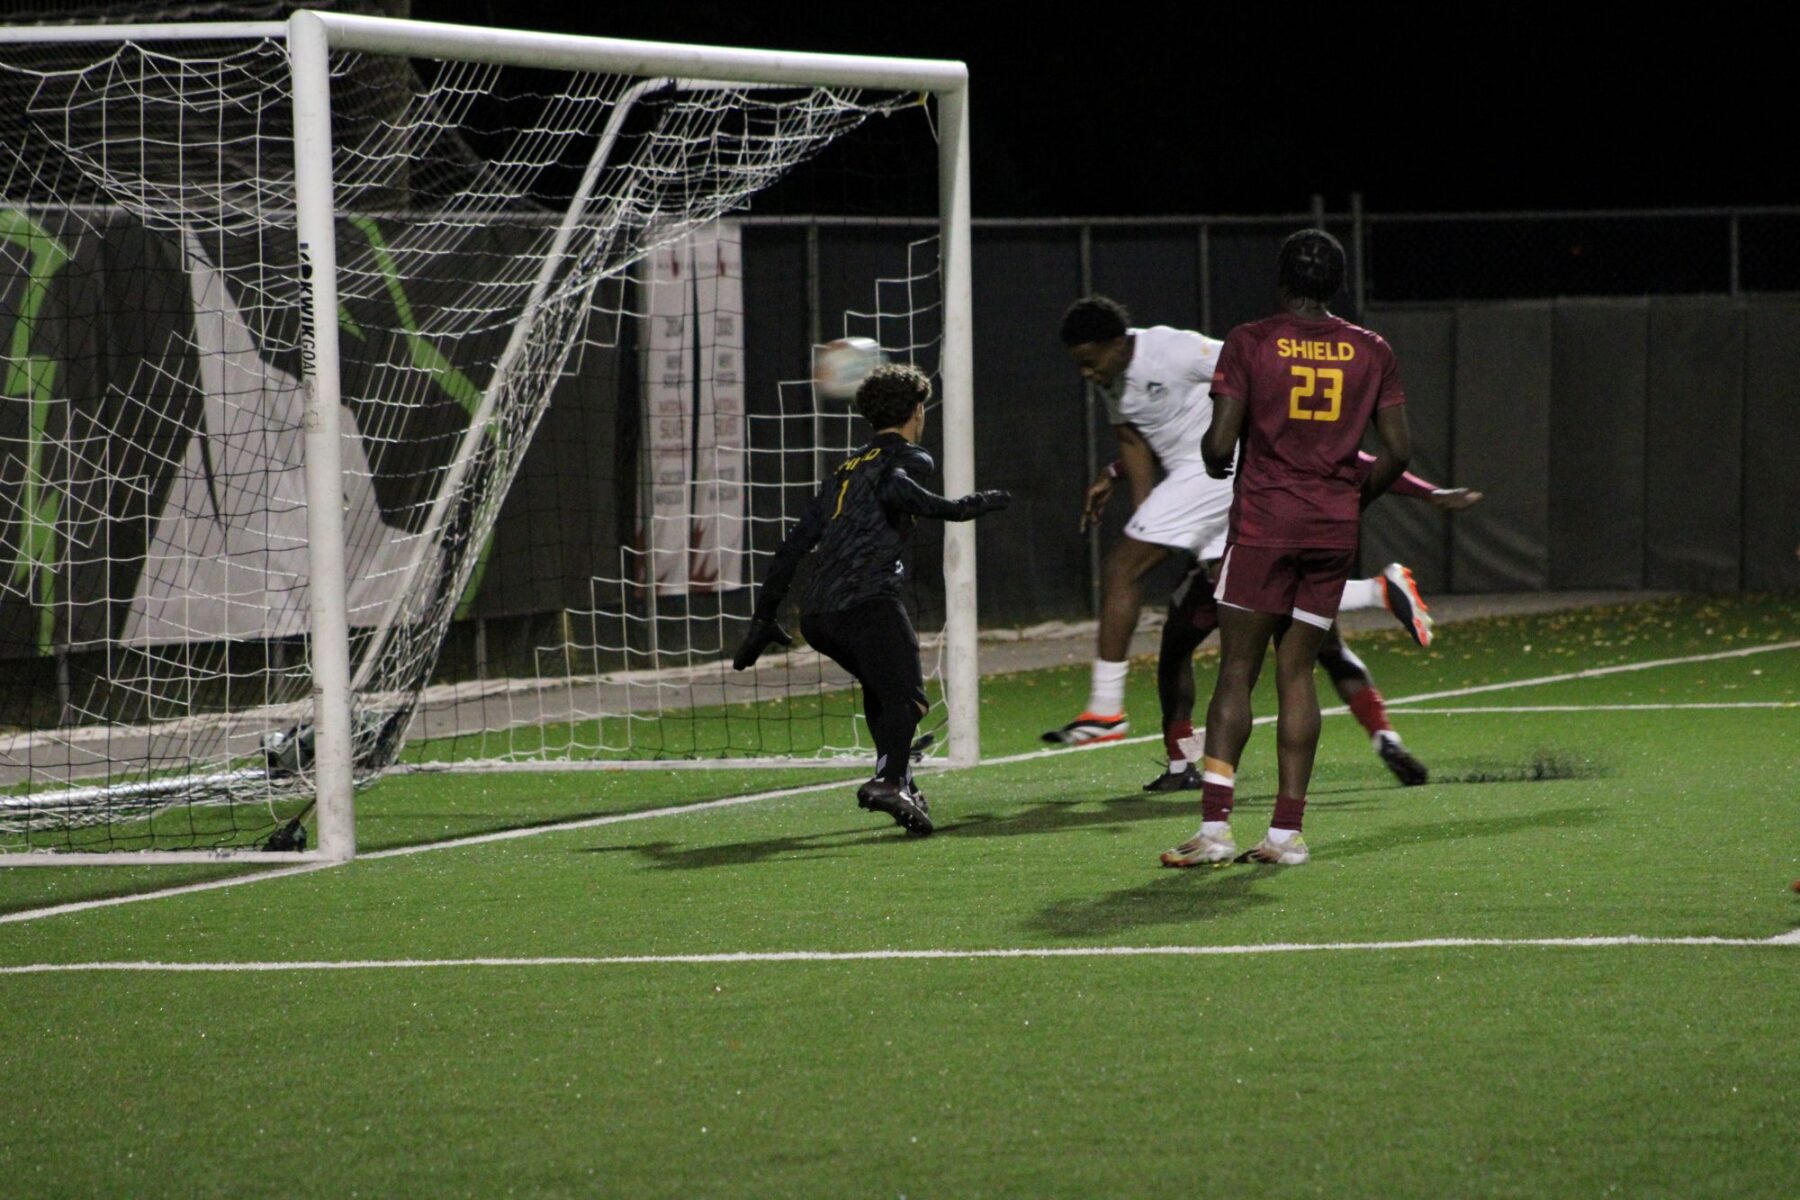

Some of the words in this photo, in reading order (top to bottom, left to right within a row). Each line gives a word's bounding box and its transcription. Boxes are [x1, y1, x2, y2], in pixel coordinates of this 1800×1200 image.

[1277, 338, 1355, 361] SHIELD
[1289, 365, 1343, 421] 23
[832, 479, 849, 519] 1
